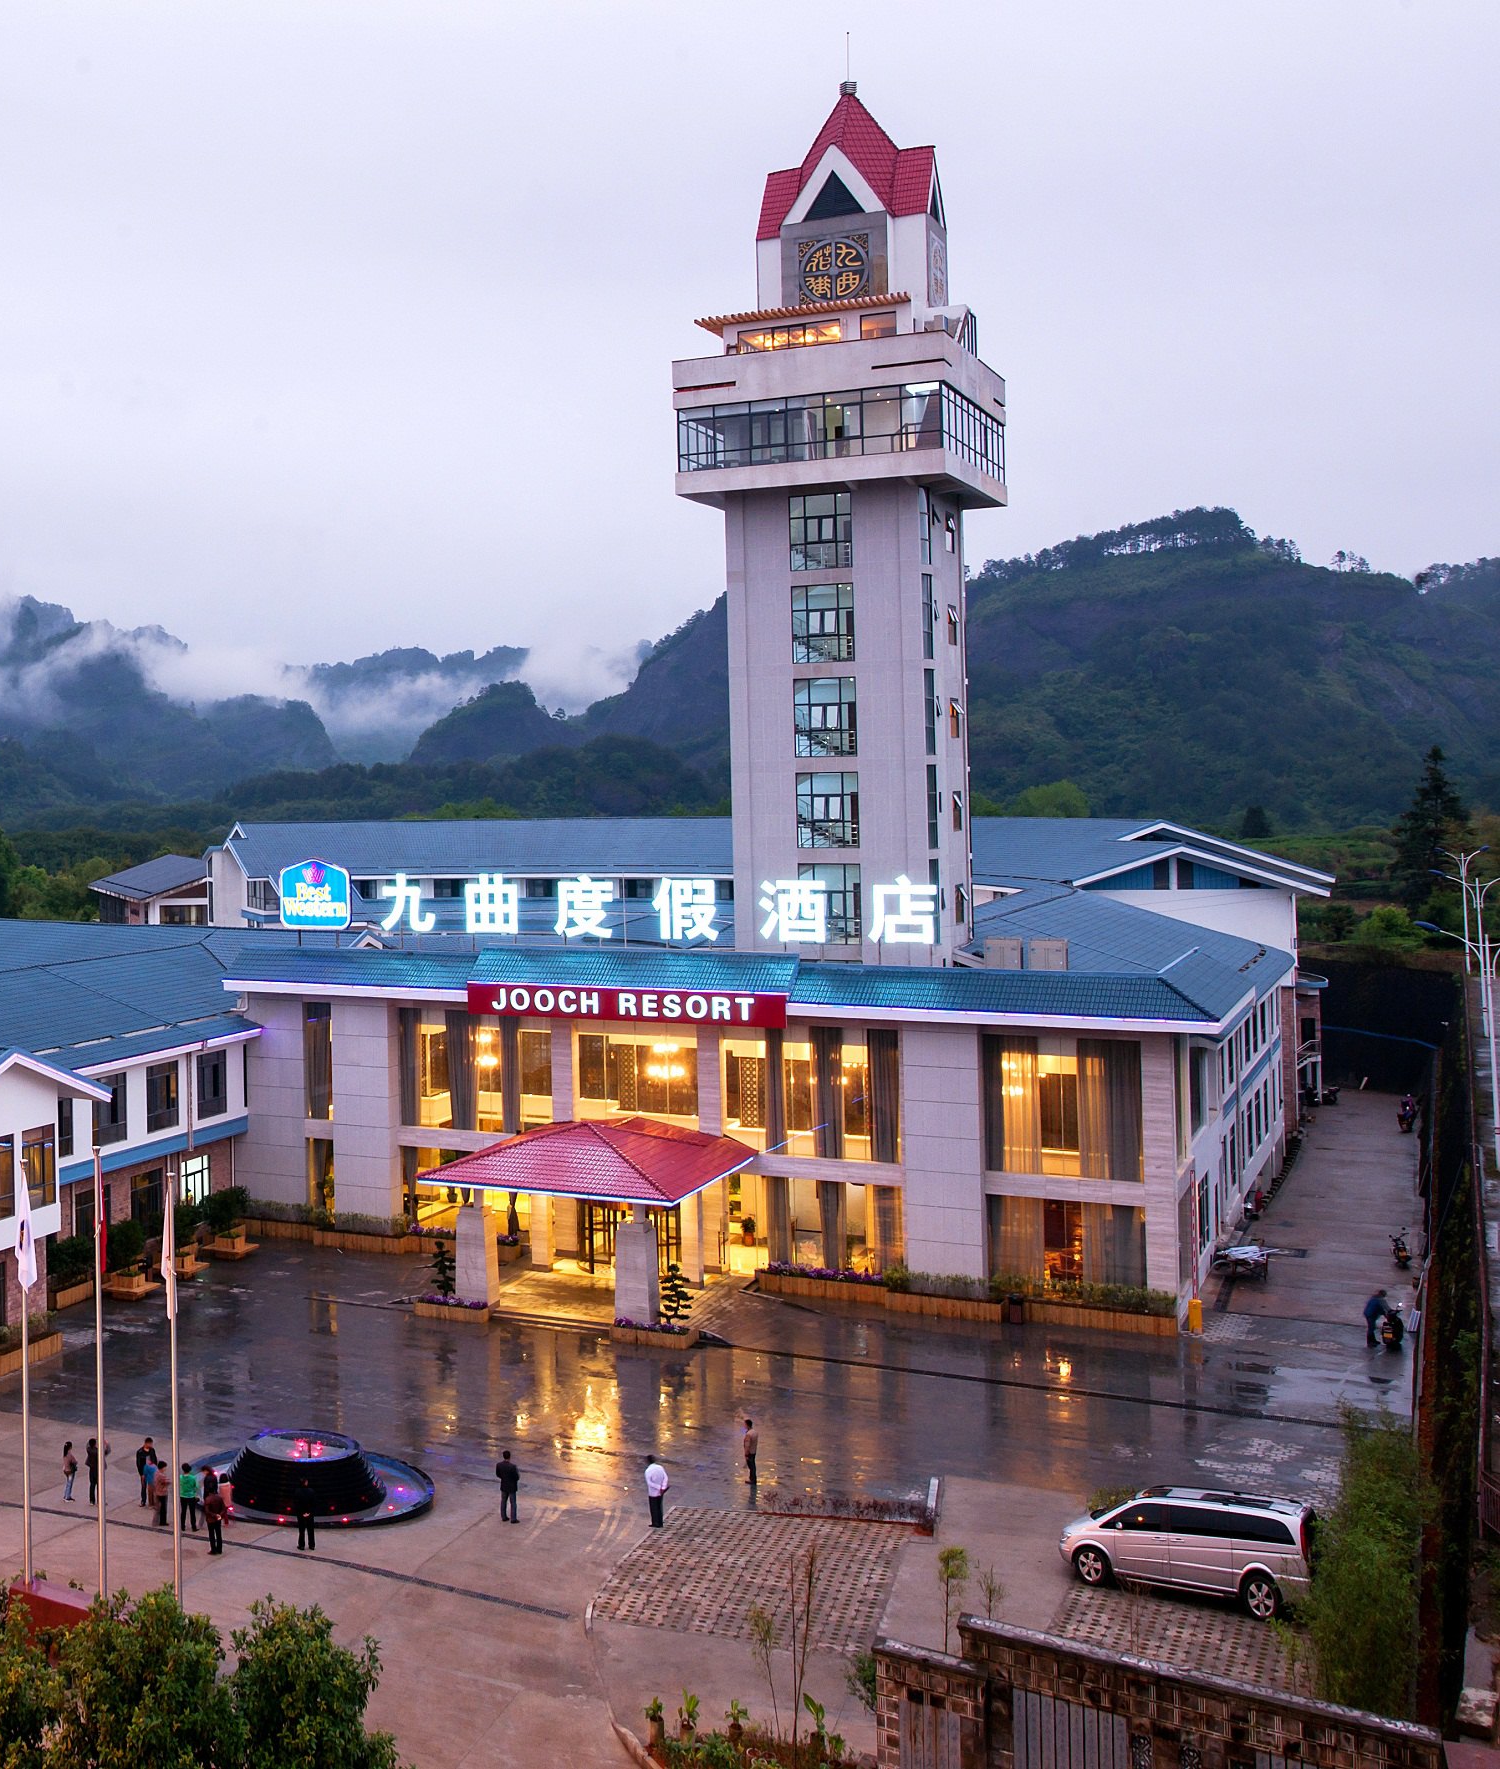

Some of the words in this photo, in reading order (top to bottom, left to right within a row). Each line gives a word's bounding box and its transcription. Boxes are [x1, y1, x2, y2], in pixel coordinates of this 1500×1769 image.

[295, 881, 332, 902] Best
[283, 897, 347, 917] Western
[380, 872, 938, 945] 九曲度假酒店
[491, 988, 600, 1015] JOOCH
[617, 992, 755, 1022] RESORT
